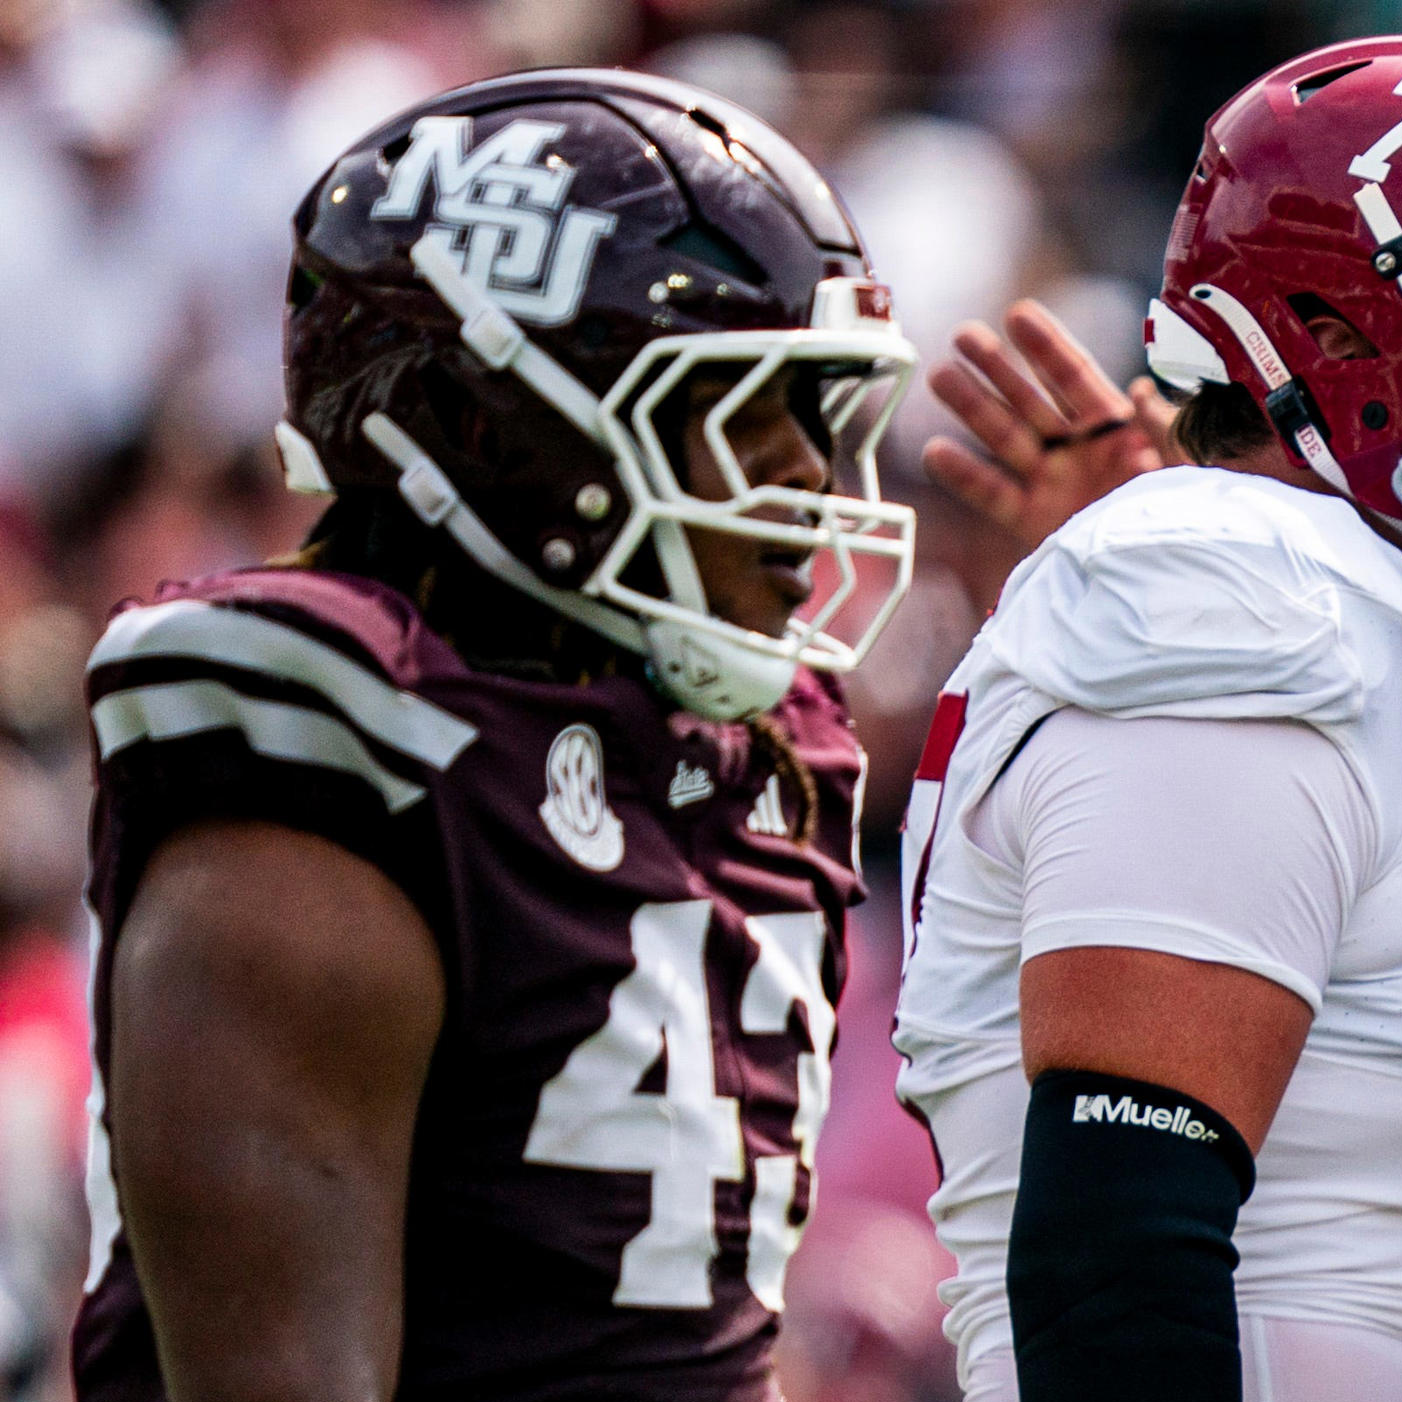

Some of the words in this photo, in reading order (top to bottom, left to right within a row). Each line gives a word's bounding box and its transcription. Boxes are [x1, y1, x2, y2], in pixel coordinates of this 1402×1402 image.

[370, 116, 619, 327] MSU
[1245, 330, 1288, 388] CRIMS
[523, 899, 837, 1312] 43
[1096, 1094, 1220, 1143] Mueller
